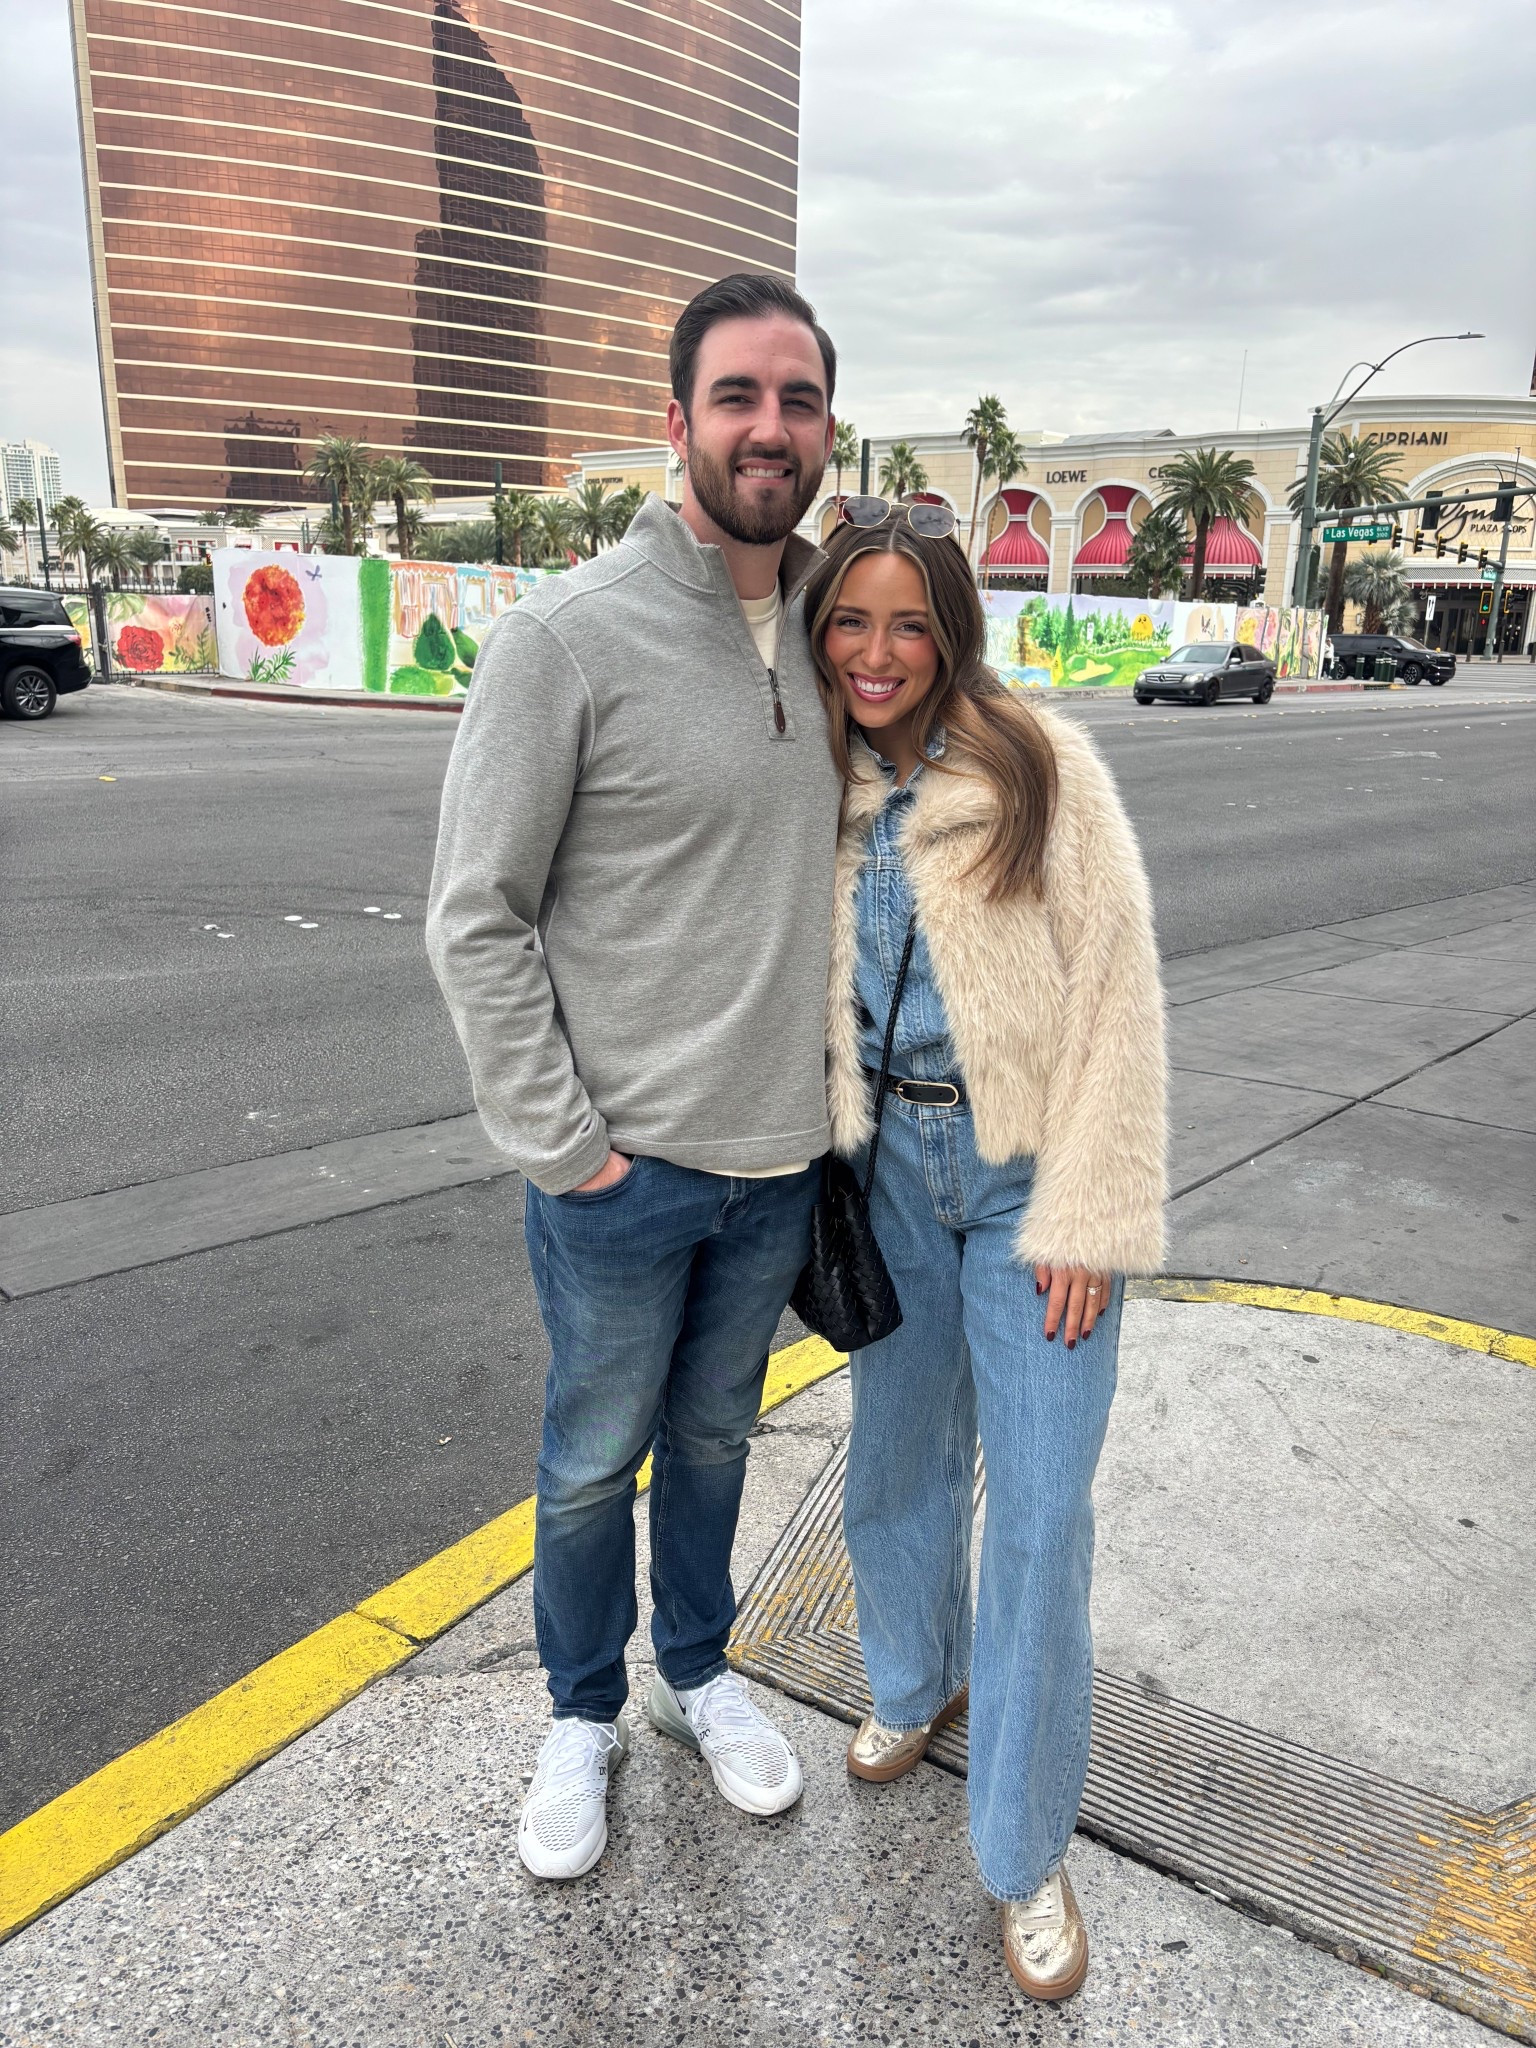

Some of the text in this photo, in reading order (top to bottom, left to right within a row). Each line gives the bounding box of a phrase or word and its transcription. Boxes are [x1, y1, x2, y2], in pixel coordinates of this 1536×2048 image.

[1368, 431, 1448, 446] CIPRIANI
[1046, 469, 1087, 484] LOEWE
[1331, 528, 1346, 539] Las
[1348, 526, 1374, 540] Vegas
[1470, 523, 1498, 533] PLAZA
